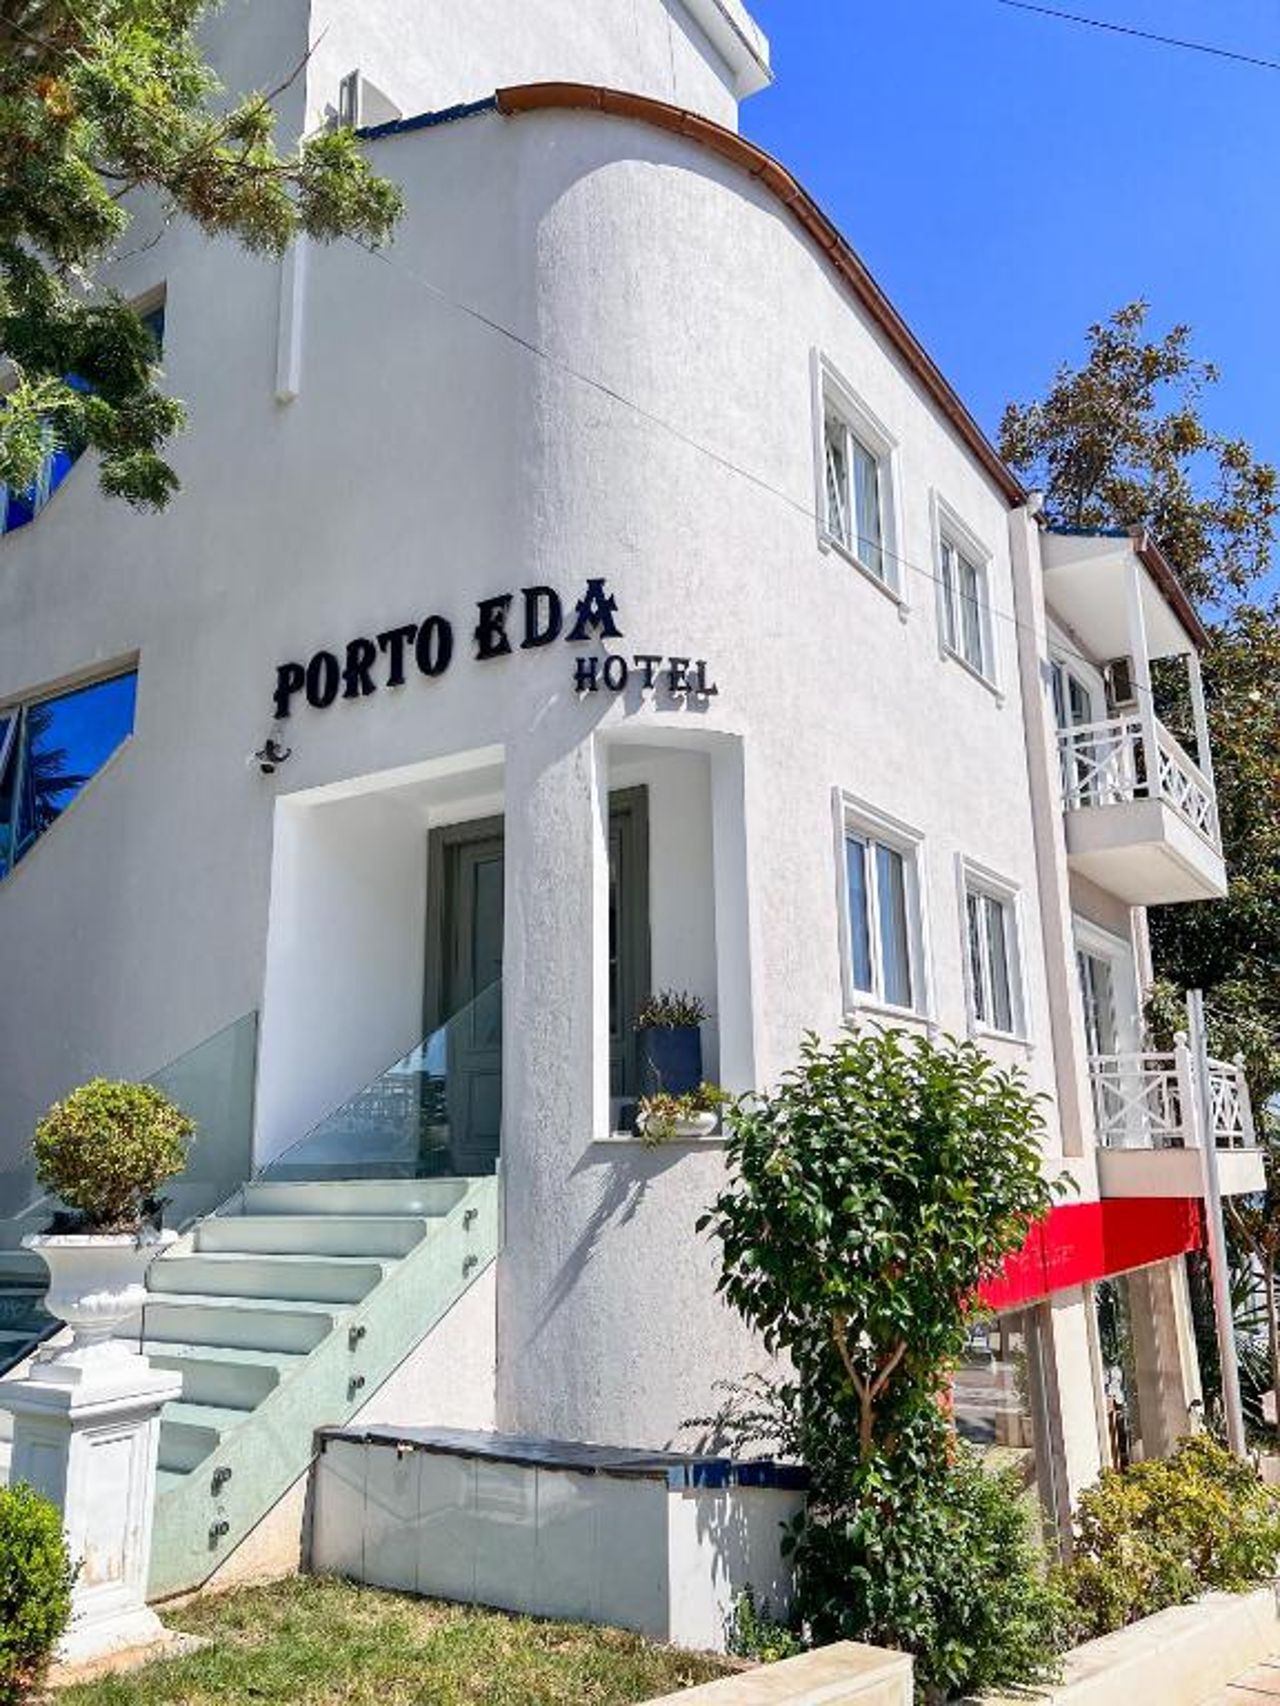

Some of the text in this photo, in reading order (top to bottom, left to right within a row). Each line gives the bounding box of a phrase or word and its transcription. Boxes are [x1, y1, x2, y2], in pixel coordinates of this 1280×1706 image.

[273, 578, 624, 719] PORTO EDA
[574, 655, 718, 696] HOTEL
